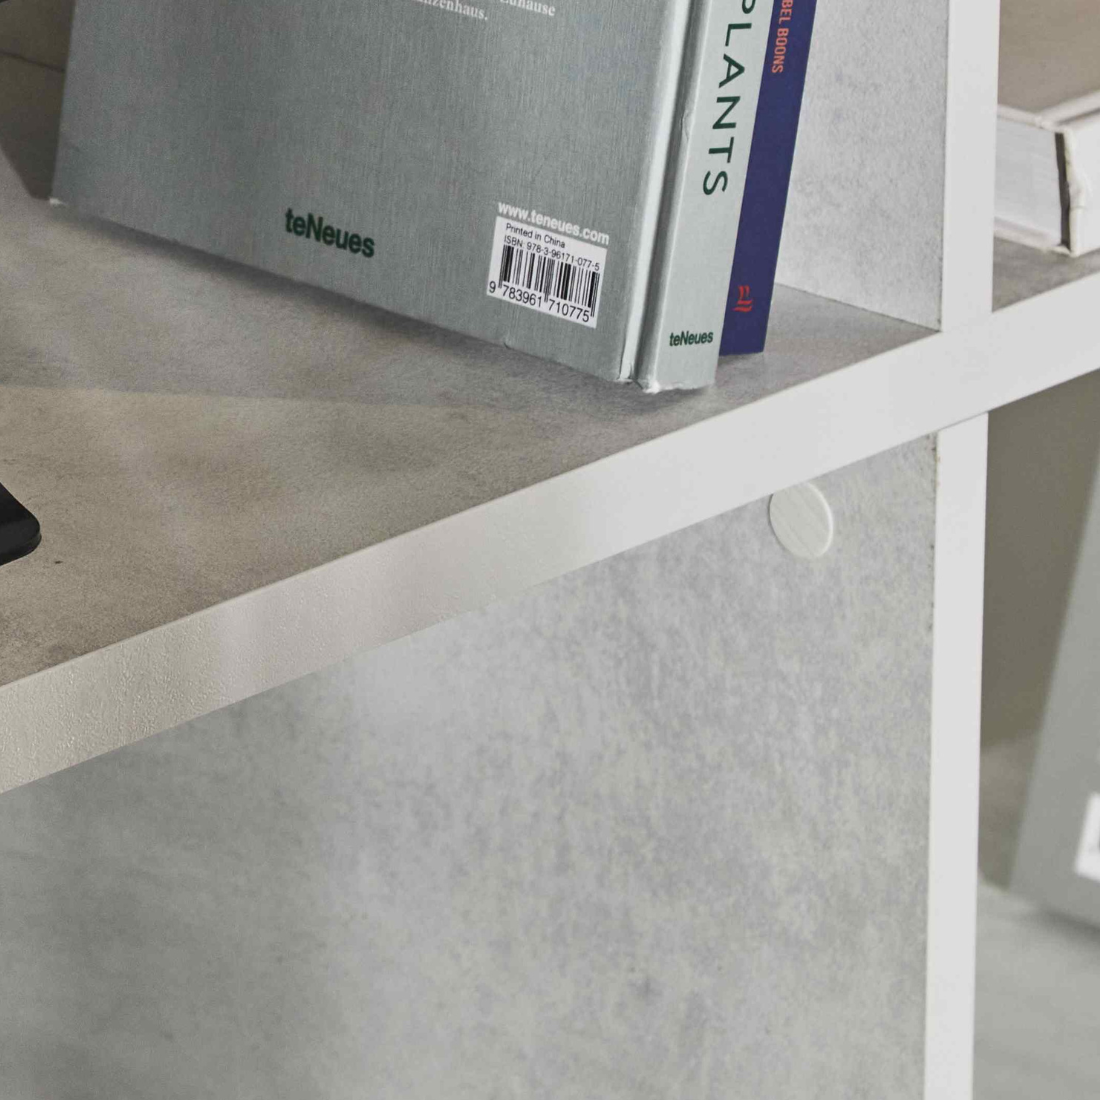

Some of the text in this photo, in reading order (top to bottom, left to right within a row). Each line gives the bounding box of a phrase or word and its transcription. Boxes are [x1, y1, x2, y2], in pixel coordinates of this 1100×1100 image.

[771, 27, 790, 74] BOONS
[284, 206, 376, 260] teNeues
[498, 201, 610, 246] www.teneues.com
[506, 222, 566, 249] Printed in China
[526, 241, 600, 272] 978-3-96171-077-5
[488, 280, 590, 323] 9 783961 710775
[669, 330, 714, 347] teNeues
